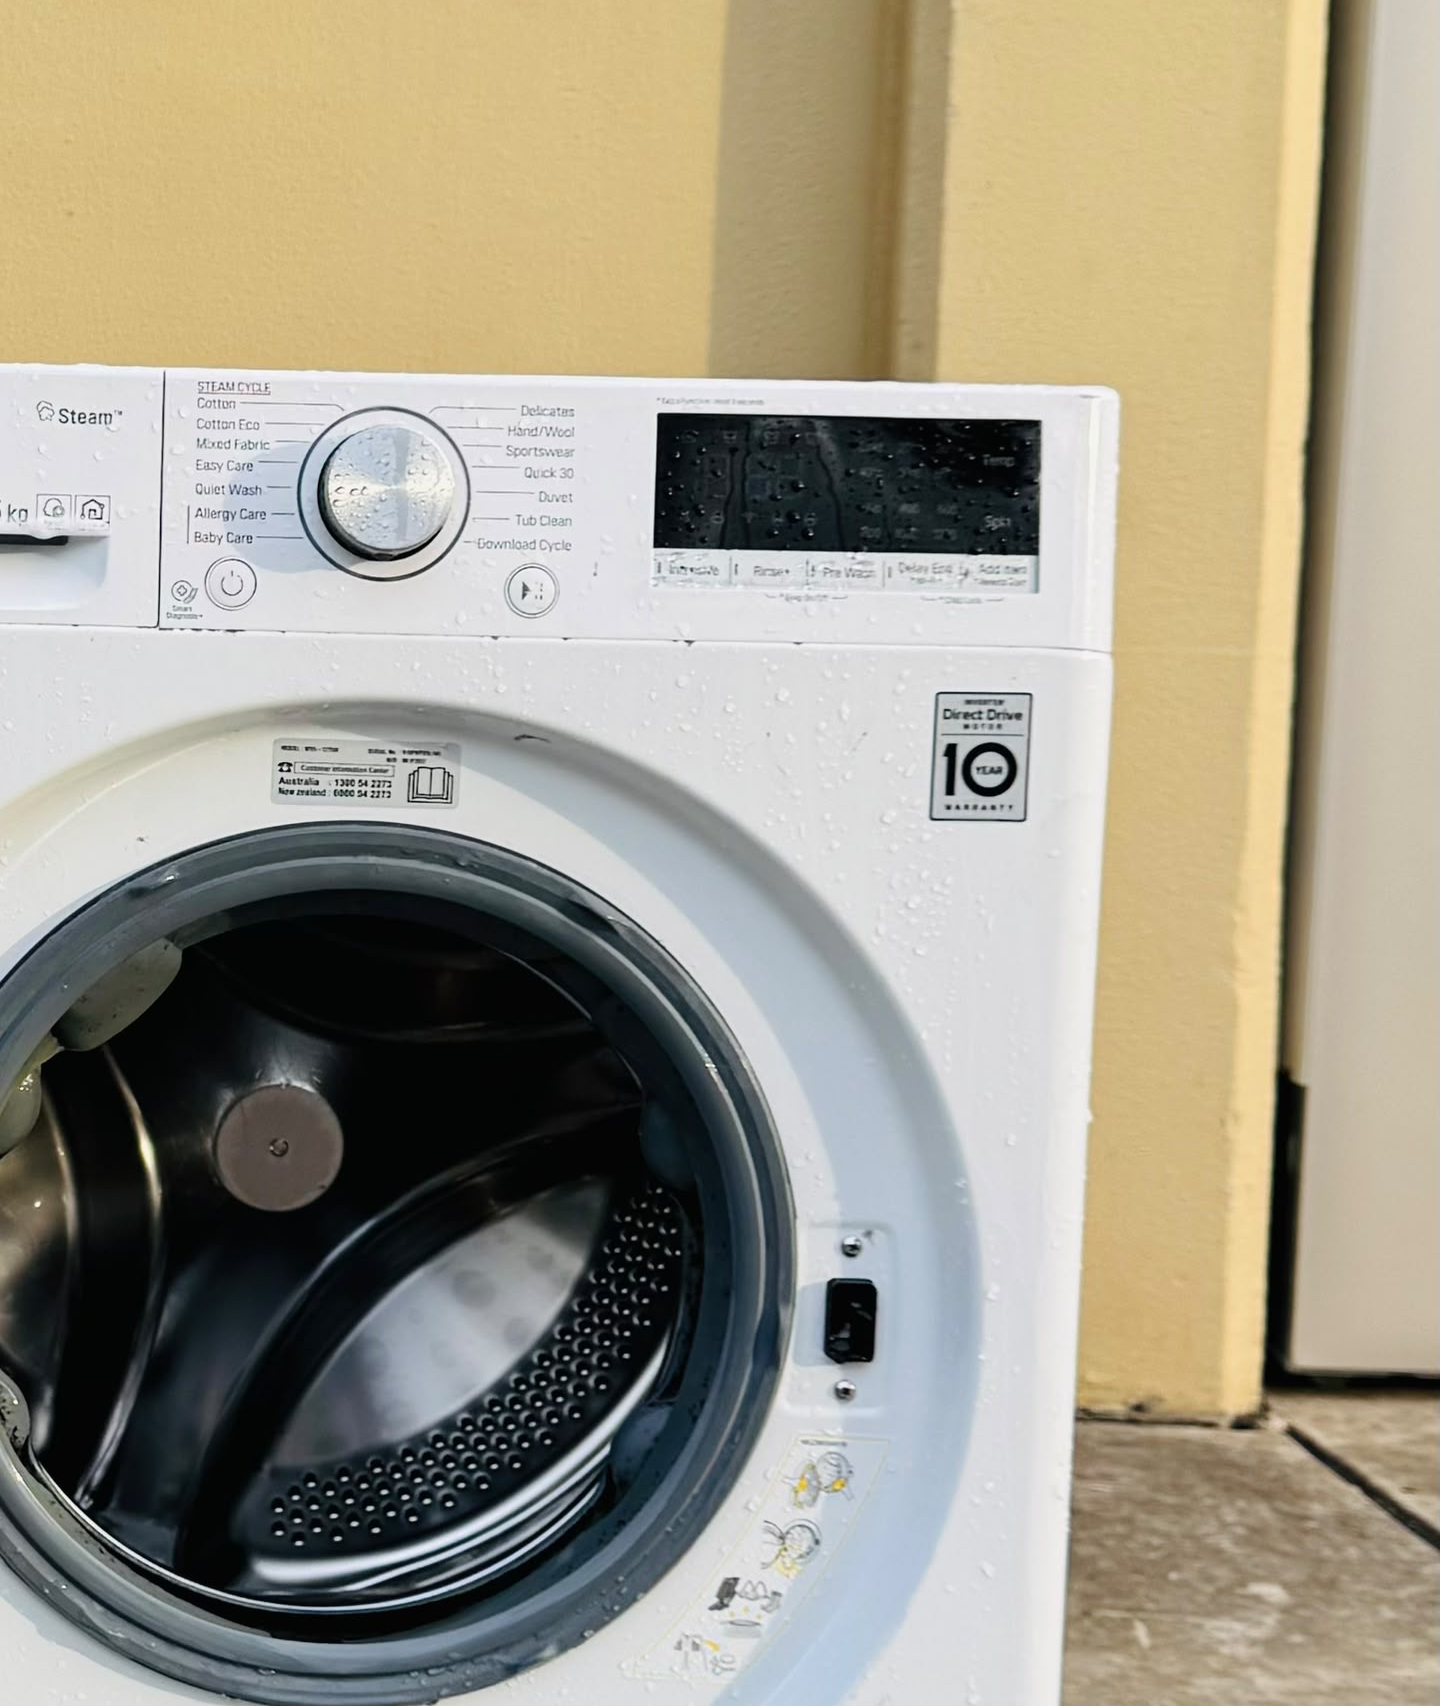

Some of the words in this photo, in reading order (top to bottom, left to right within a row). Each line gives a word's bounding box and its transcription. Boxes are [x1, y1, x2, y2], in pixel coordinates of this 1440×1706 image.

[197, 381, 235, 392] STEAM
[238, 381, 271, 393] CYCLE
[197, 397, 236, 410] Cotton
[521, 404, 575, 418] Delicates
[196, 418, 236, 430] Cotton
[239, 419, 260, 431] Eco
[507, 425, 575, 438] Hand/Wool
[196, 437, 231, 450] Mixed
[234, 438, 271, 451] Fabric
[506, 445, 575, 459] Sportswear
[195, 459, 224, 473] Easy
[227, 460, 254, 472] Care
[524, 466, 558, 479] Quick
[560, 467, 575, 479] 30
[195, 483, 226, 495] Quiet
[228, 484, 263, 496] Wash
[538, 491, 573, 503] Duvet
[8, 503, 29, 524] kg
[195, 507, 237, 522] Allergy
[240, 508, 267, 520] Care
[515, 514, 537, 526] Tub
[540, 515, 573, 527] Clean
[194, 531, 223, 545] Baby
[227, 532, 254, 544] Care
[477, 538, 537, 550] Download
[539, 539, 573, 552] Cycle
[942, 708, 983, 721] Direct
[986, 708, 1023, 721] Drive
[942, 741, 1018, 798] 10
[975, 765, 1003, 775] YEAR
